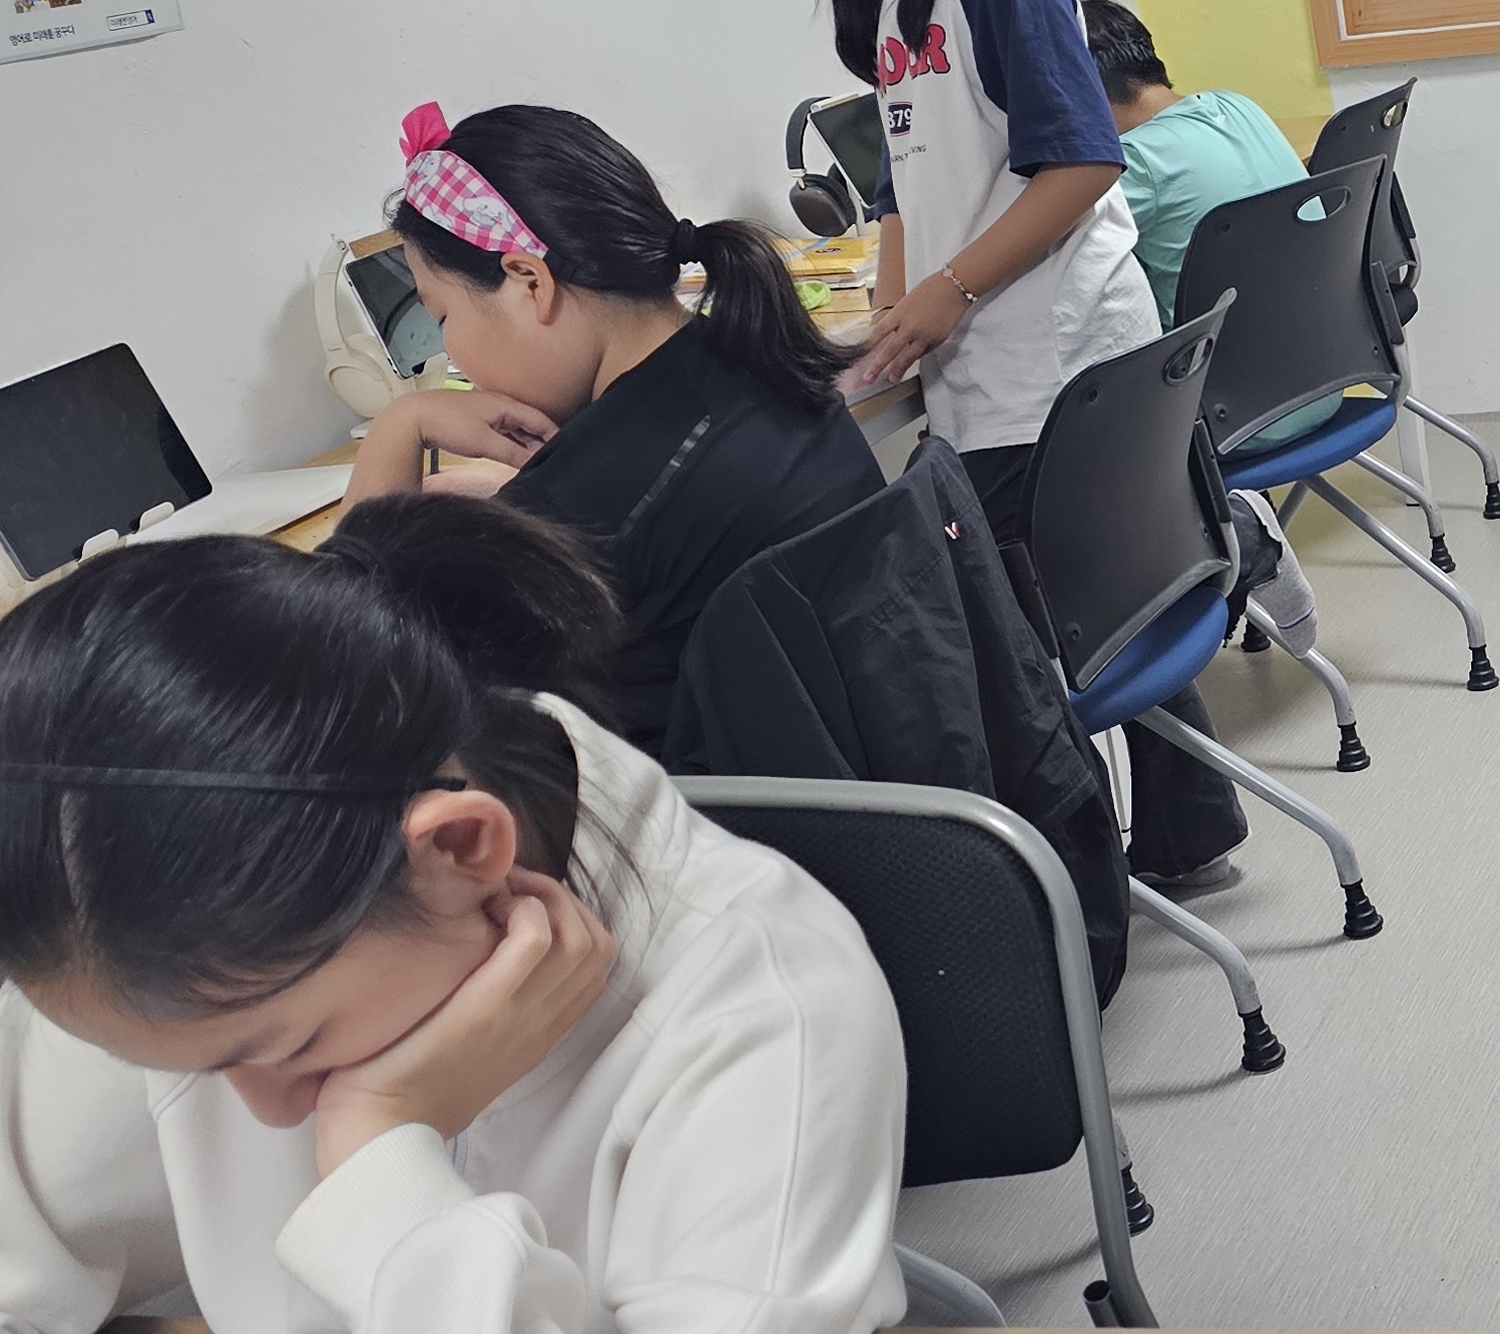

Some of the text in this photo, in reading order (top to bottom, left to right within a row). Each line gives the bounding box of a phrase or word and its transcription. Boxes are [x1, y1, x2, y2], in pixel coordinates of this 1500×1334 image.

[9, 25, 75, 46] 영어로 미래를 꿈꾸다
